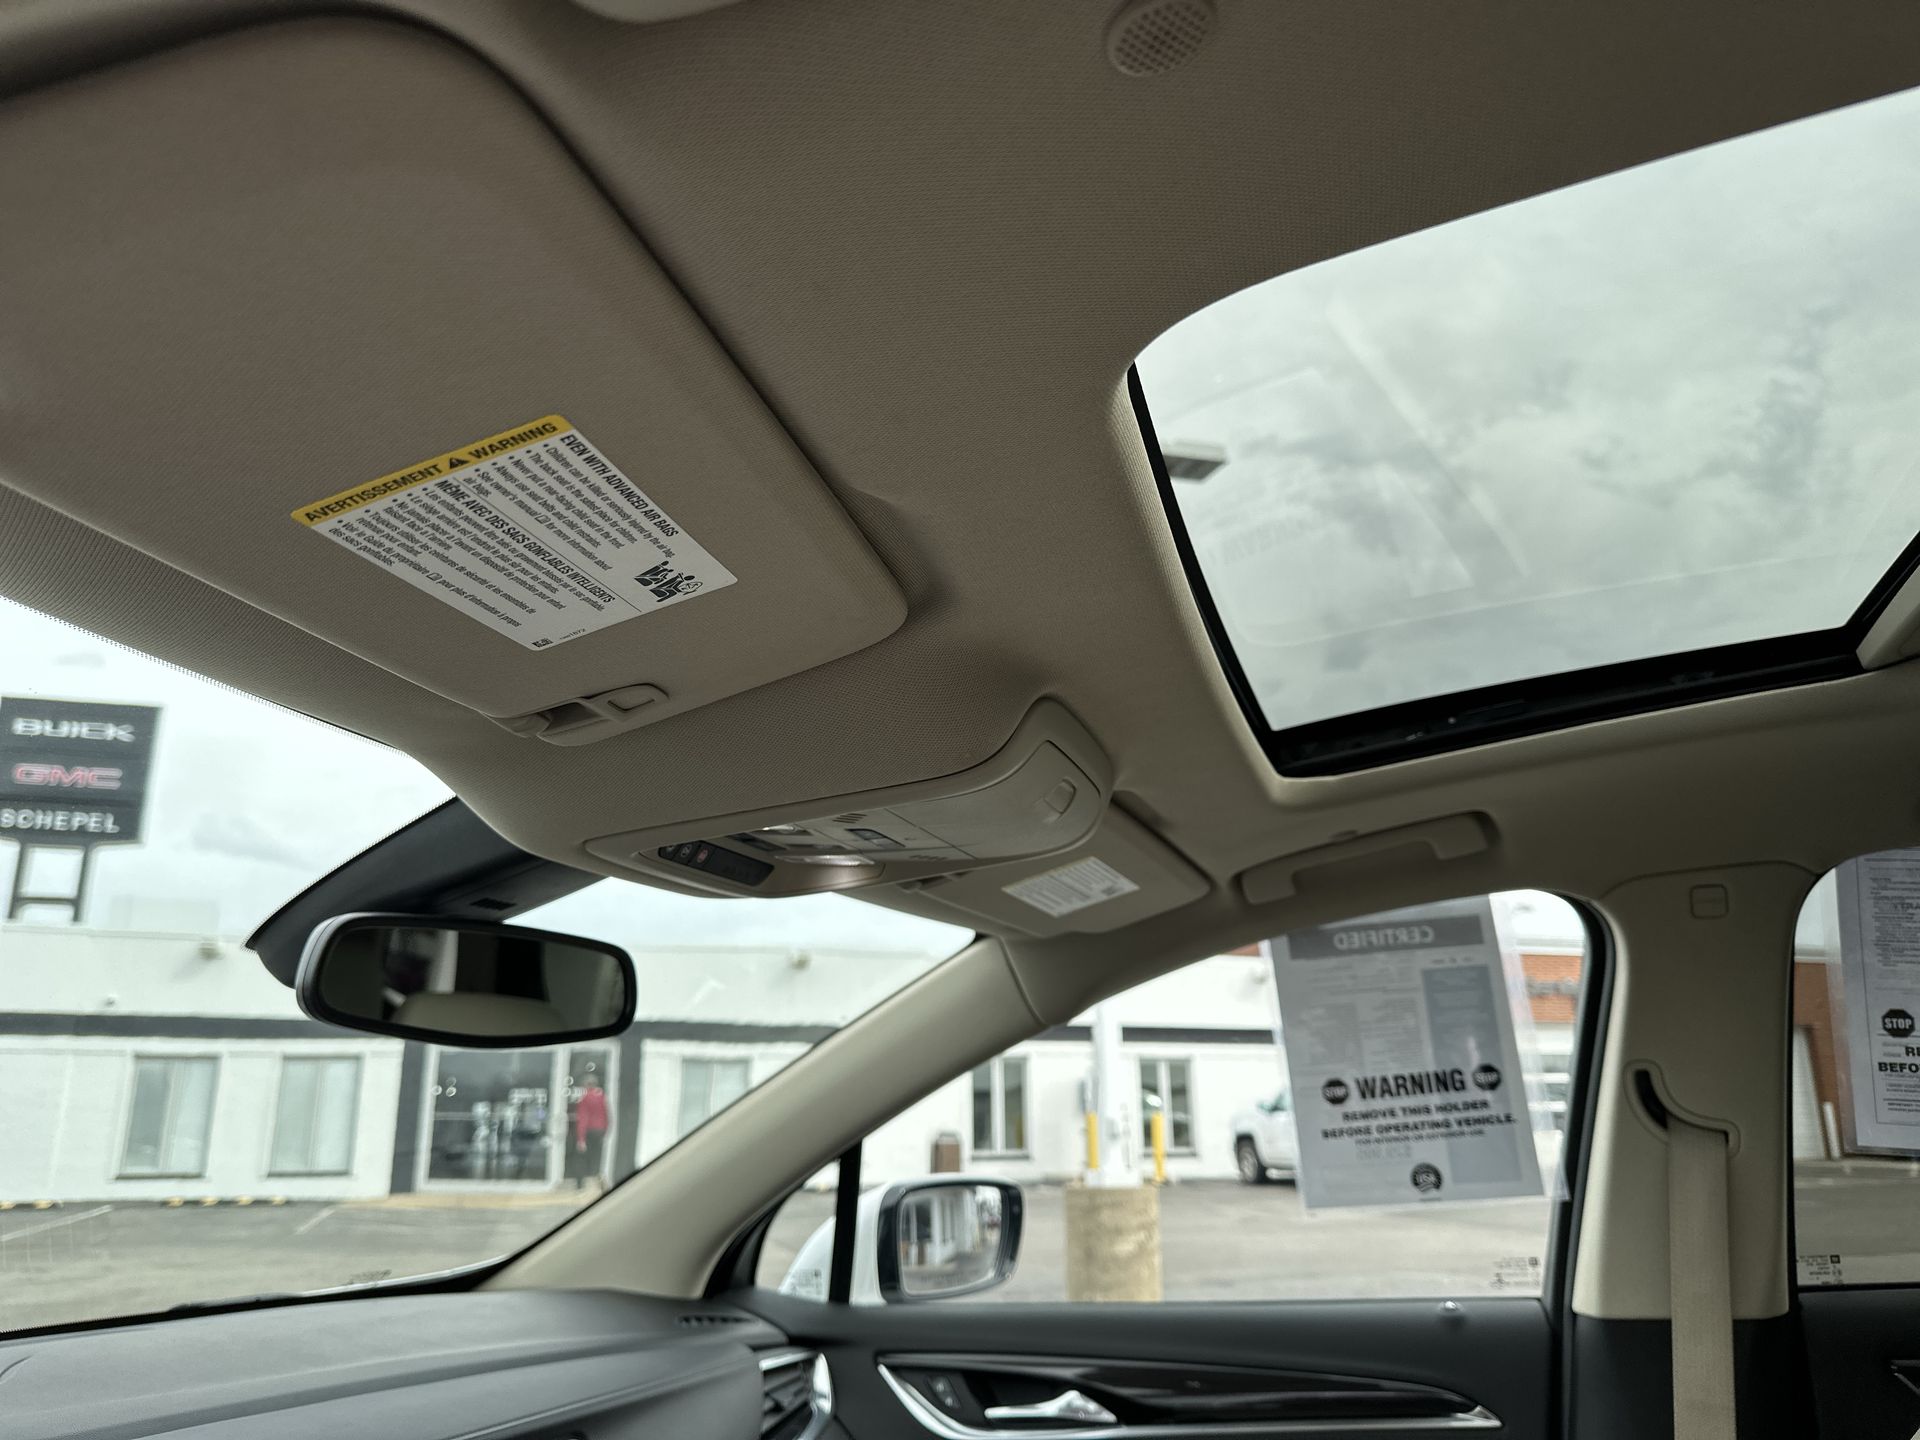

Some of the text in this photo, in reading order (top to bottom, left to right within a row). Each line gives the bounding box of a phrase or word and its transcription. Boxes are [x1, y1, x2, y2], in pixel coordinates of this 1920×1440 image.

[468, 422, 559, 460] WARNING
[304, 464, 444, 522] AVERTISSEMENT
[494, 465, 519, 483] Always
[514, 482, 530, 491] use
[525, 490, 544, 502] seat
[538, 499, 556, 512] belts
[551, 511, 568, 520] and
[562, 519, 580, 530] child
[511, 458, 533, 474] Never
[525, 473, 544, 483] put
[543, 485, 575, 510] rear-facing
[571, 508, 590, 520] child
[583, 518, 600, 529] seat
[599, 531, 612, 539] the
[529, 452, 543, 464] The
[539, 462, 558, 476] back
[553, 474, 571, 486] seat
[570, 488, 584, 498] the
[579, 497, 601, 511] safest
[593, 509, 612, 522] place
[546, 447, 572, 469] Children
[568, 468, 583, 478] can
[578, 476, 590, 484] be
[586, 483, 606, 497] killed
[606, 501, 631, 520] seriously
[627, 519, 649, 534] injured
[642, 531, 653, 539] by
[648, 537, 660, 545] the
[560, 434, 678, 536] EVEN WITH ADVANCED AIR BAGS
[425, 490, 441, 500] Les
[437, 499, 463, 516] enfants
[459, 515, 488, 532] peuvent
[514, 552, 546, 571] gravement
[477, 471, 612, 570] See owner's manual for more information about
[434, 480, 615, 602] MÊME AVEC DES SACS GONFLABLES INTELLIGENTS
[494, 553, 512, 563] plus
[515, 567, 533, 576] pour
[508, 575, 538, 593] protection
[532, 591, 550, 600] pour
[12, 718, 135, 742] BUICK
[11, 763, 123, 790] GMC
[0, 808, 120, 833] SCHEPEL
[1883, 1017, 1912, 1030] STOP
[1354, 1068, 1466, 1099] WARNING
[1878, 1061, 1920, 1074] BEFO
[1321, 1124, 1372, 1139] BEFORE
[1376, 1118, 1453, 1134] OPERATING
[1455, 1113, 1517, 1127] VEHICLE.
[1342, 1099, 1490, 1122] REMOVE THIS HOLDER
